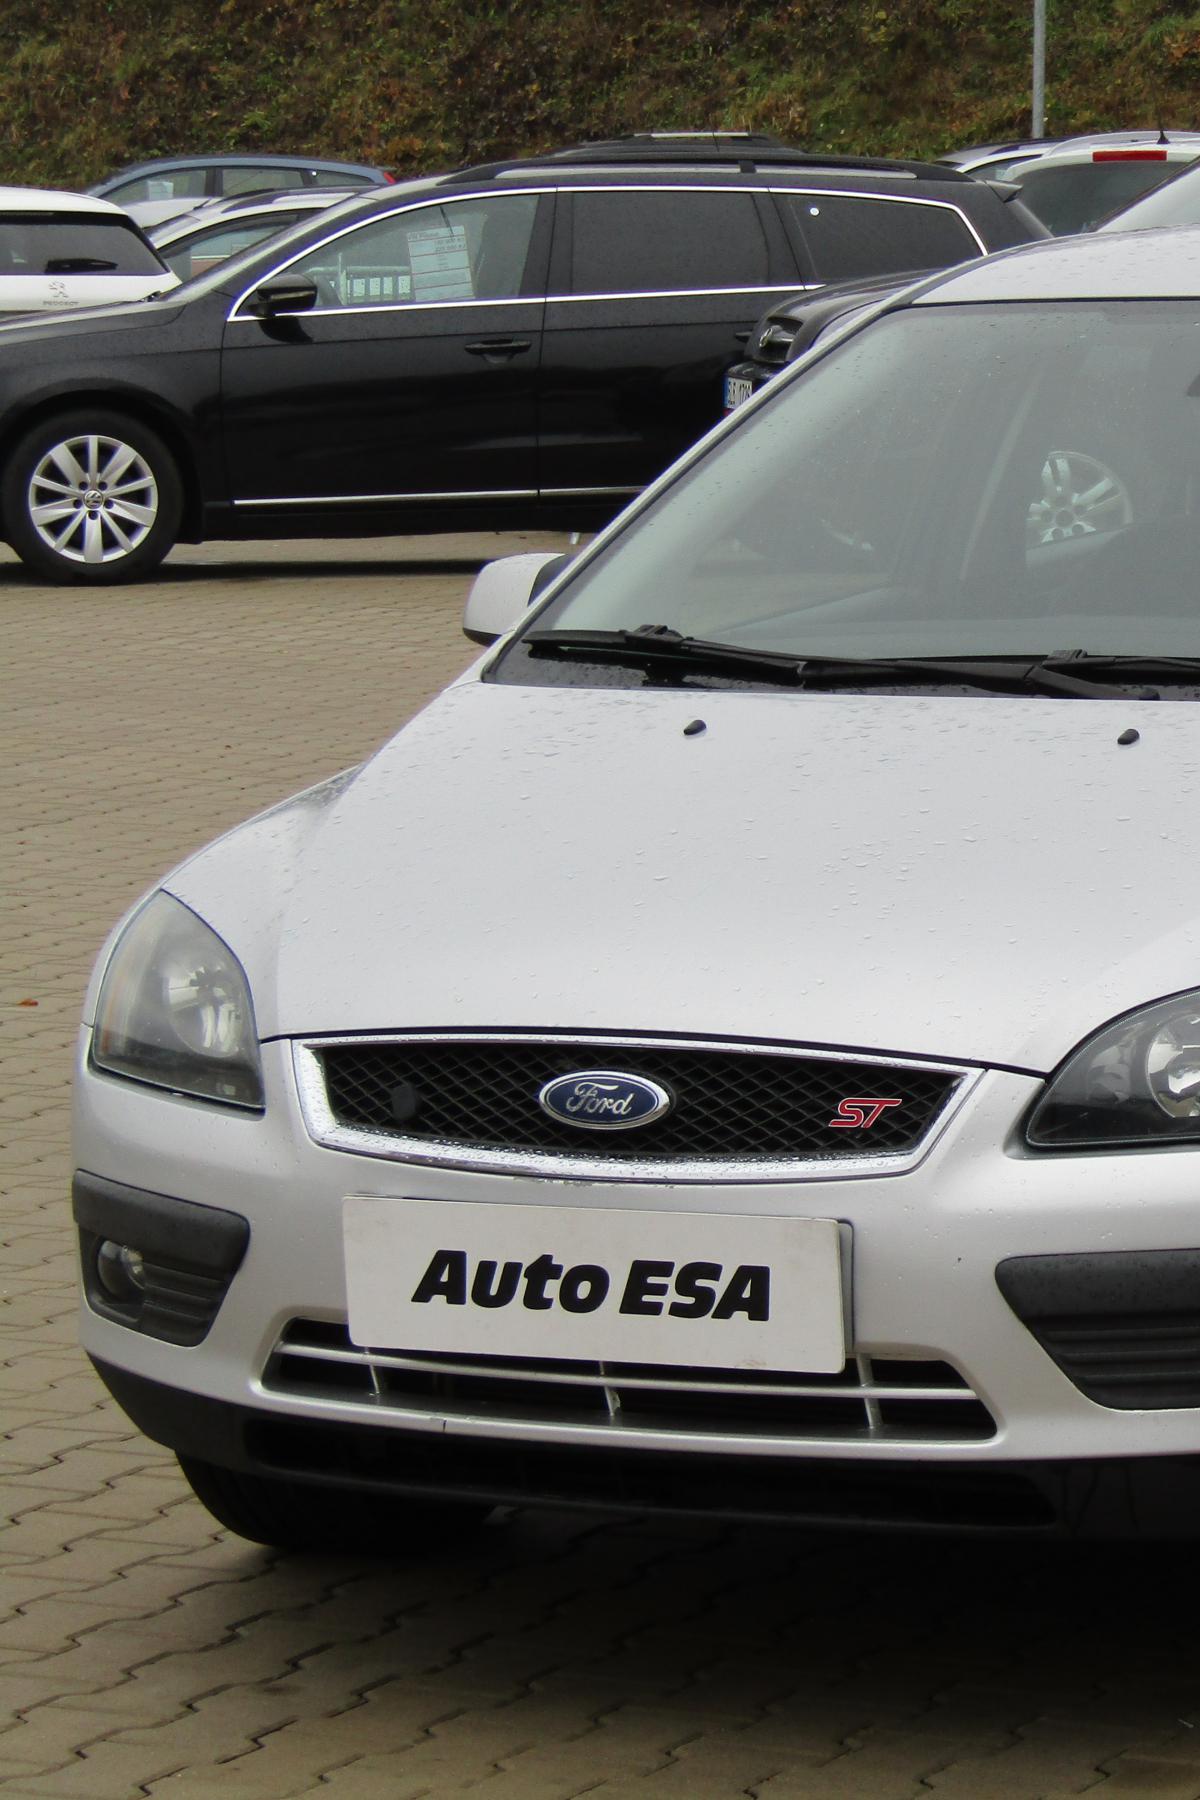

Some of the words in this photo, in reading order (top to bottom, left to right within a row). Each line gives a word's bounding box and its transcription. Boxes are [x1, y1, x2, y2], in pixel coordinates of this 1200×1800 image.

[566, 1082, 635, 1115] Ford
[828, 1097, 902, 1128] ST
[410, 1249, 610, 1314] Auto
[618, 1259, 771, 1322] ESA
